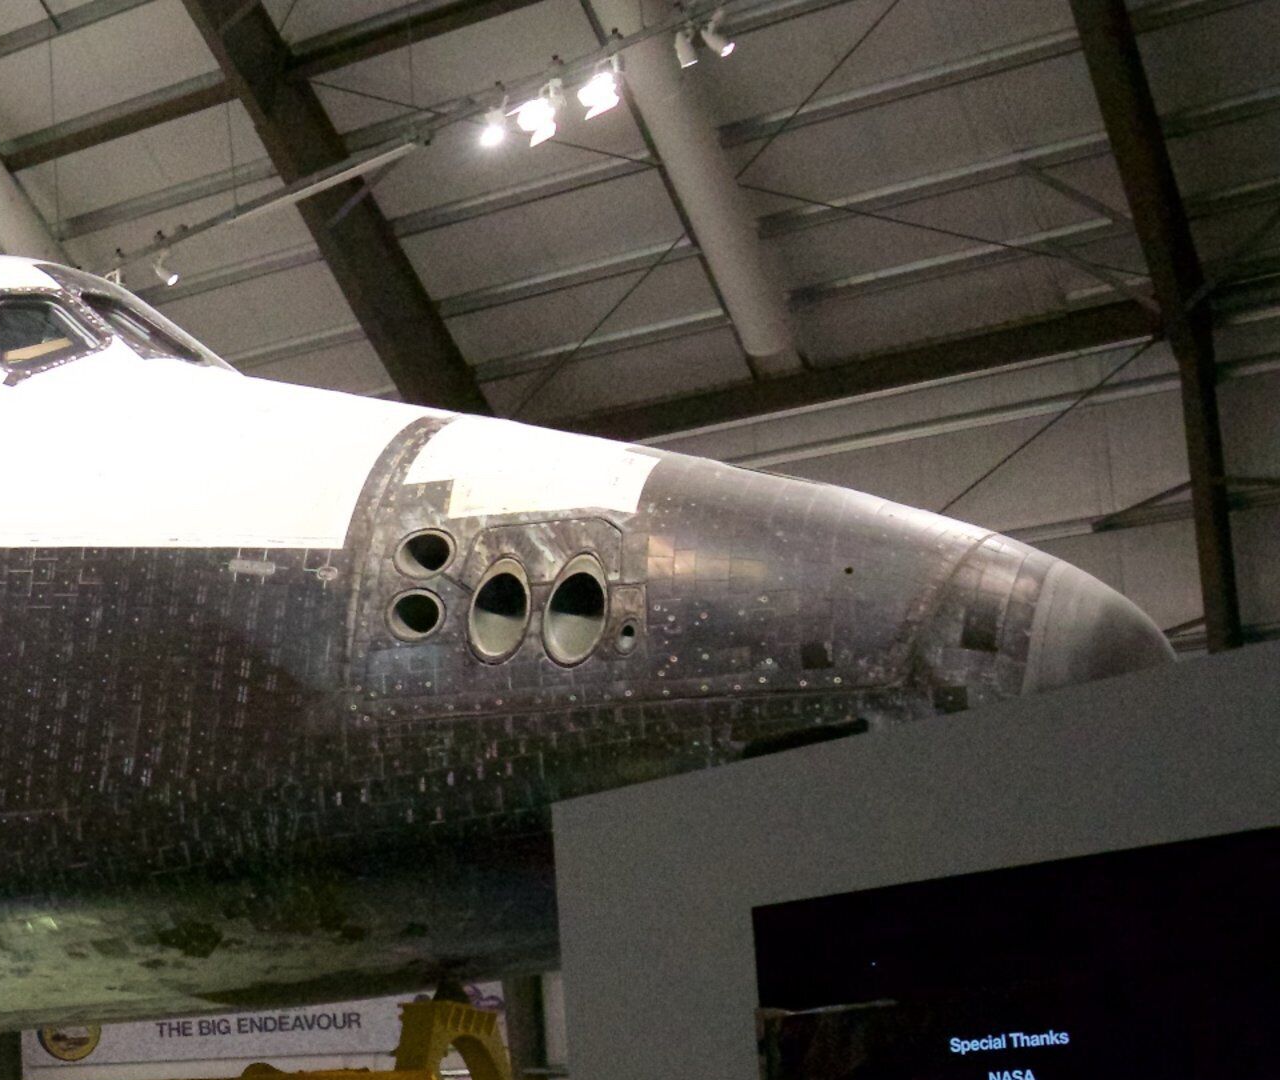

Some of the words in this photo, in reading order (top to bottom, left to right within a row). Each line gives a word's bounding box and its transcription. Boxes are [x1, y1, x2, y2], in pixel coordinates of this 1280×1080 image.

[156, 1021, 192, 1038] THE
[198, 1018, 231, 1036] BIG
[237, 1012, 361, 1034] ENDEAVOUR
[950, 1034, 1006, 1055] Special
[1009, 1030, 1069, 1048] Thanks
